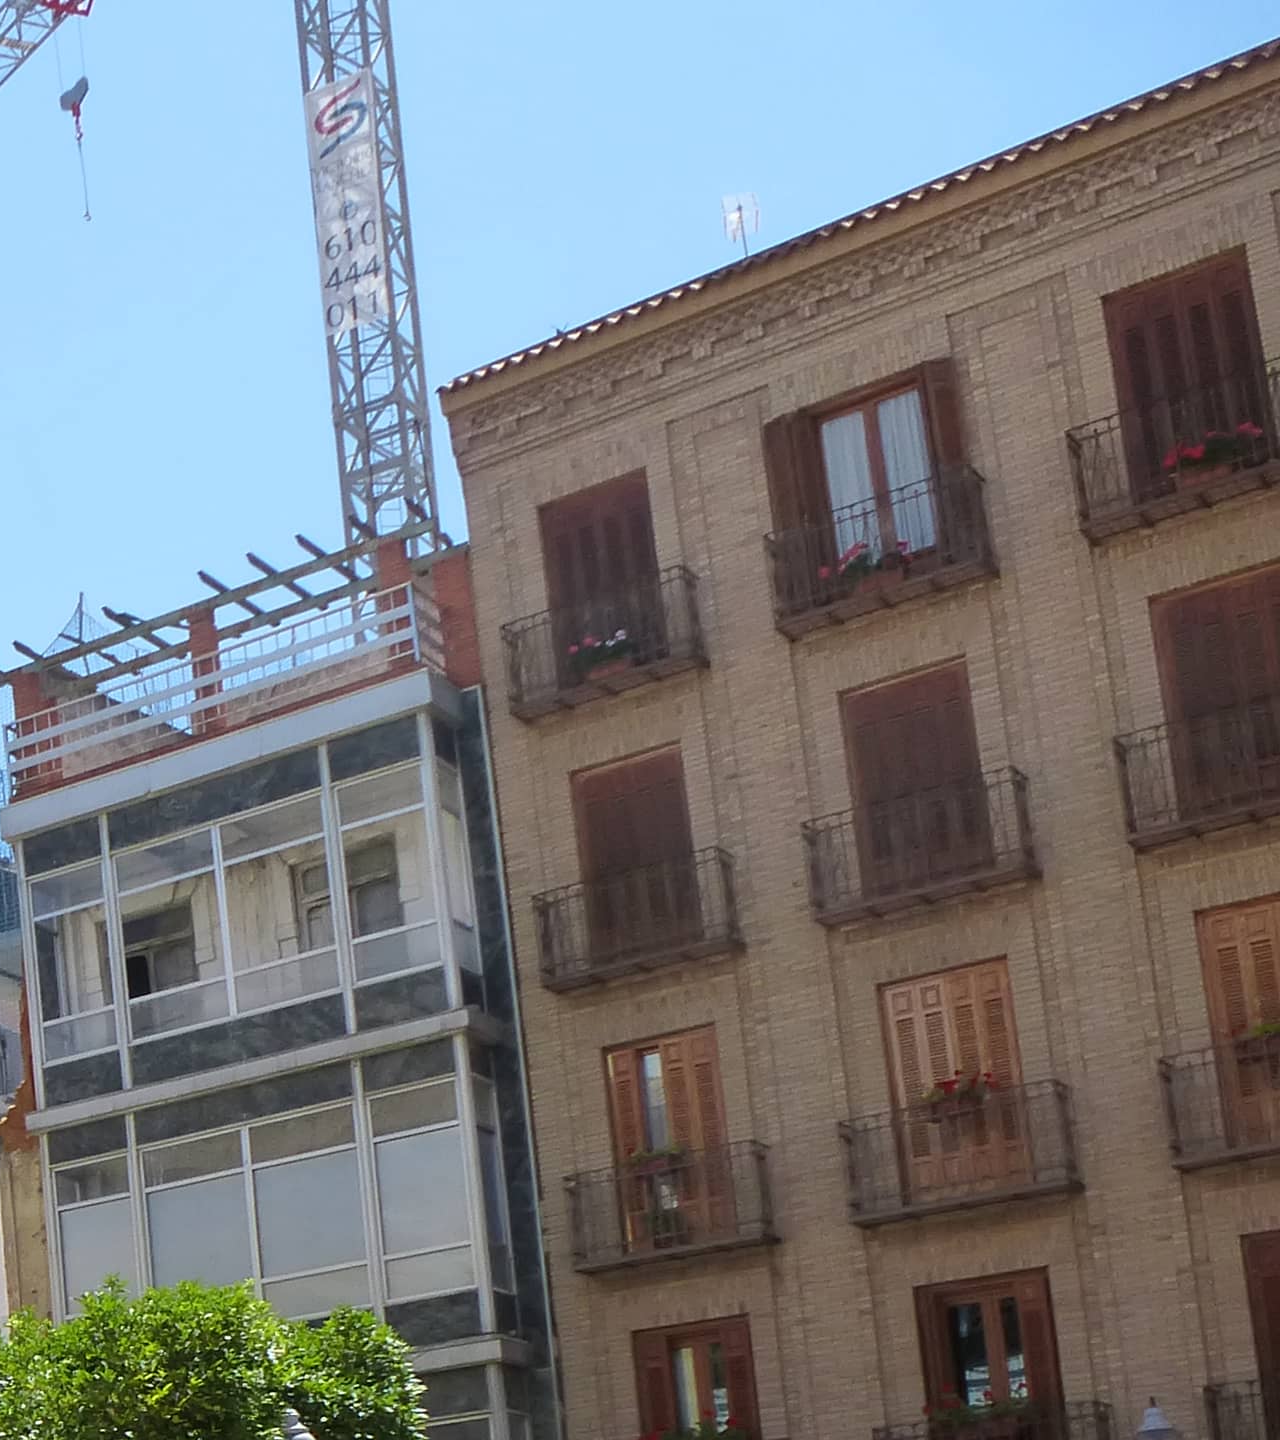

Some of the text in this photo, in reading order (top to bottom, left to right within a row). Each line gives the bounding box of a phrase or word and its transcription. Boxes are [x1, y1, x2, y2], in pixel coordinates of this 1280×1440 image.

[324, 220, 377, 260] 610
[324, 255, 380, 291] 444
[327, 290, 377, 328] 011
